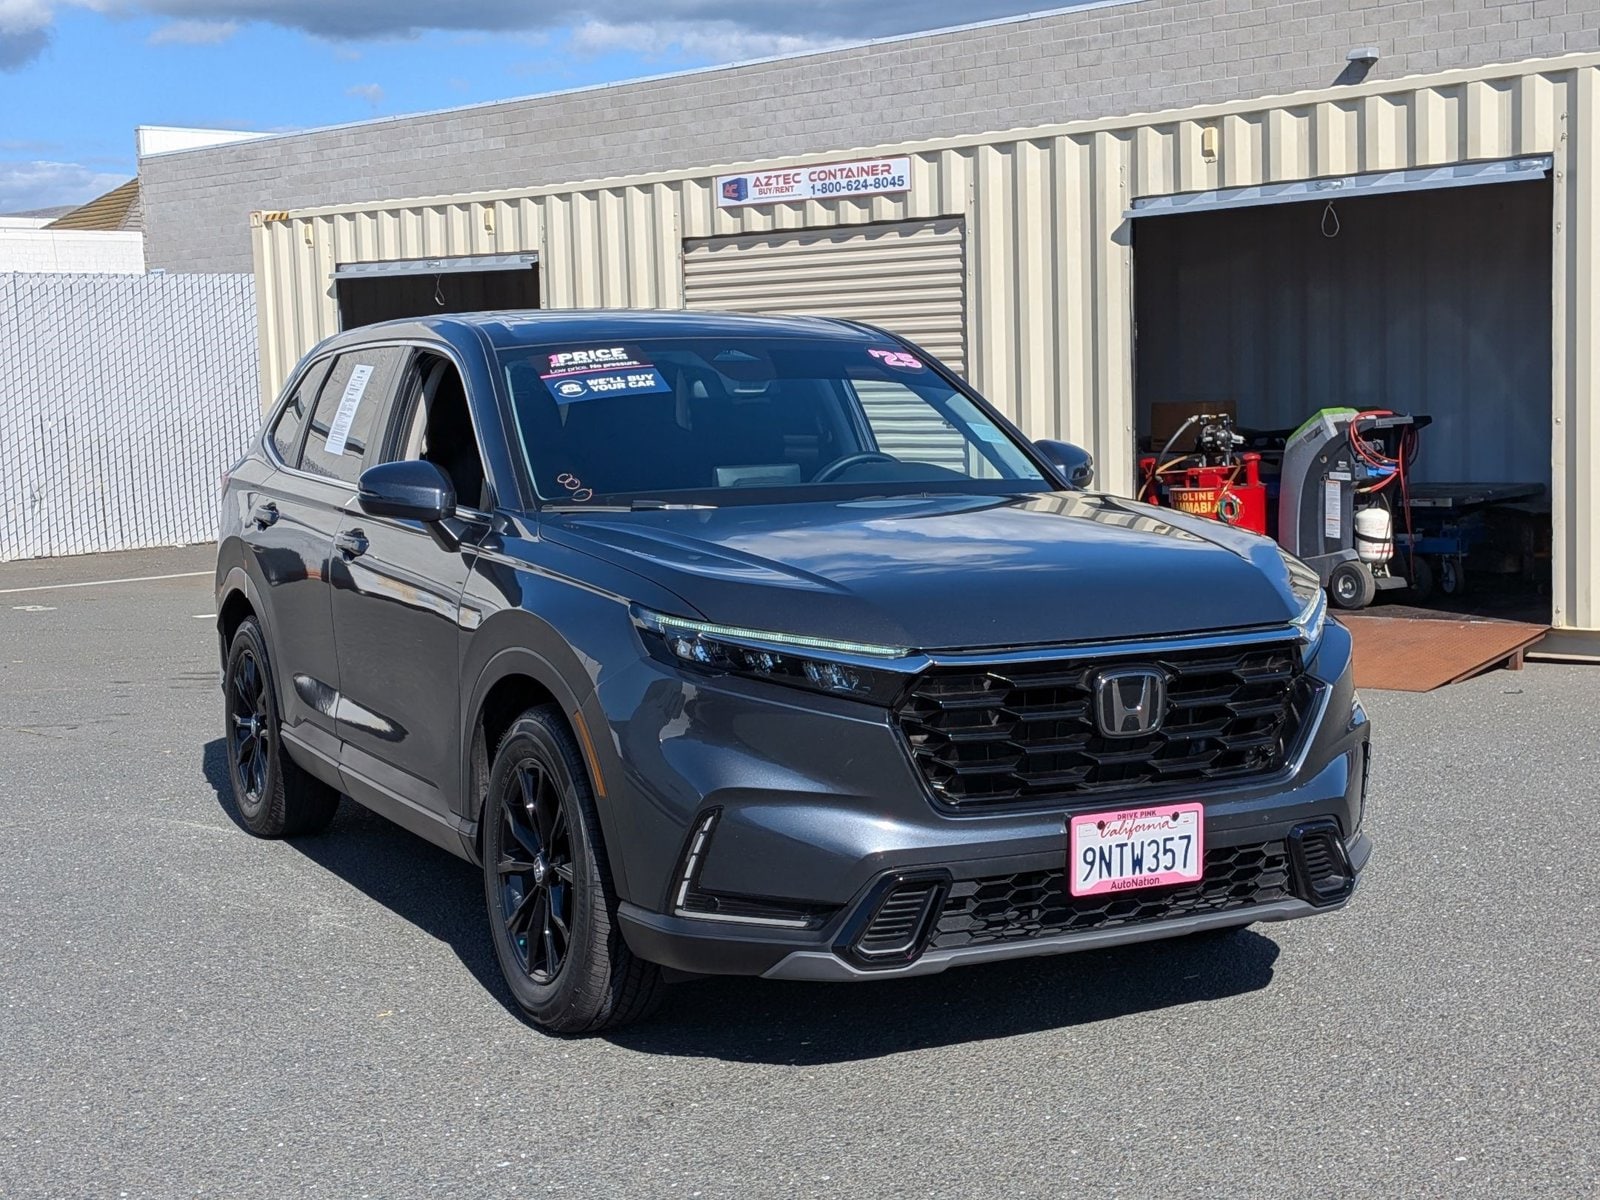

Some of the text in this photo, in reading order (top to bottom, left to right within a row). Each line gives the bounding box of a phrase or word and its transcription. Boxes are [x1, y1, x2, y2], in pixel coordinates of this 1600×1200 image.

[752, 163, 892, 188] AZTEC CONTAINER
[758, 176, 905, 196] BUY/RENT 1-800-624-8045
[550, 366, 567, 374] Low
[567, 365, 588, 373] price.
[602, 360, 640, 368] pressure.
[586, 373, 654, 386] WE'LL BUY
[590, 380, 656, 393] YOUR CAR
[1117, 810, 1157, 820] DRIVE PINK
[1100, 818, 1177, 840] California
[1082, 834, 1192, 882] 9NTW357
[1110, 876, 1161, 890] AutoNation
